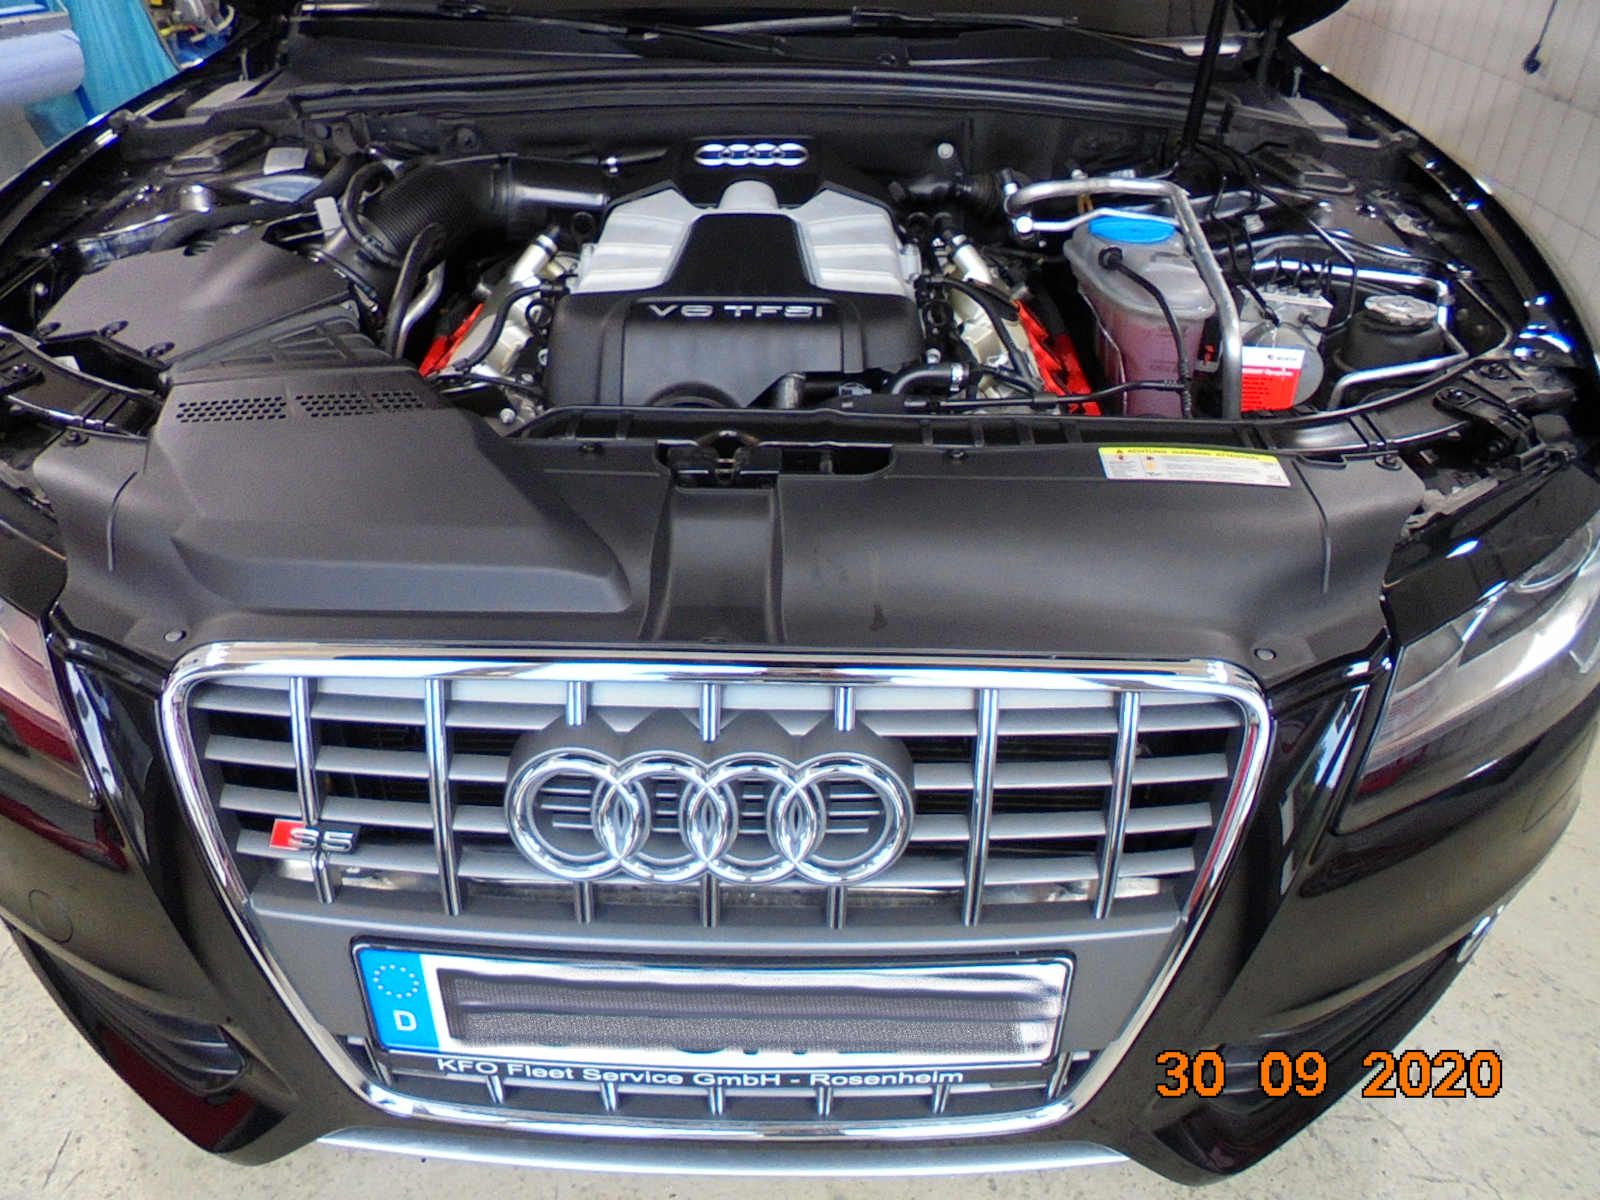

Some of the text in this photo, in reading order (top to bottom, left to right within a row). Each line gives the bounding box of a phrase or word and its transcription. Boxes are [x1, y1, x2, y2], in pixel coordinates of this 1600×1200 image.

[648, 304, 823, 317] V6 TFSI
[290, 827, 353, 852] S5
[393, 1009, 417, 1031] D
[436, 1057, 498, 1075] KFO
[507, 1063, 573, 1081] Fleet
[582, 1068, 684, 1085] Service
[692, 1072, 780, 1086] GmbH
[810, 1070, 964, 1086] Rosenheim
